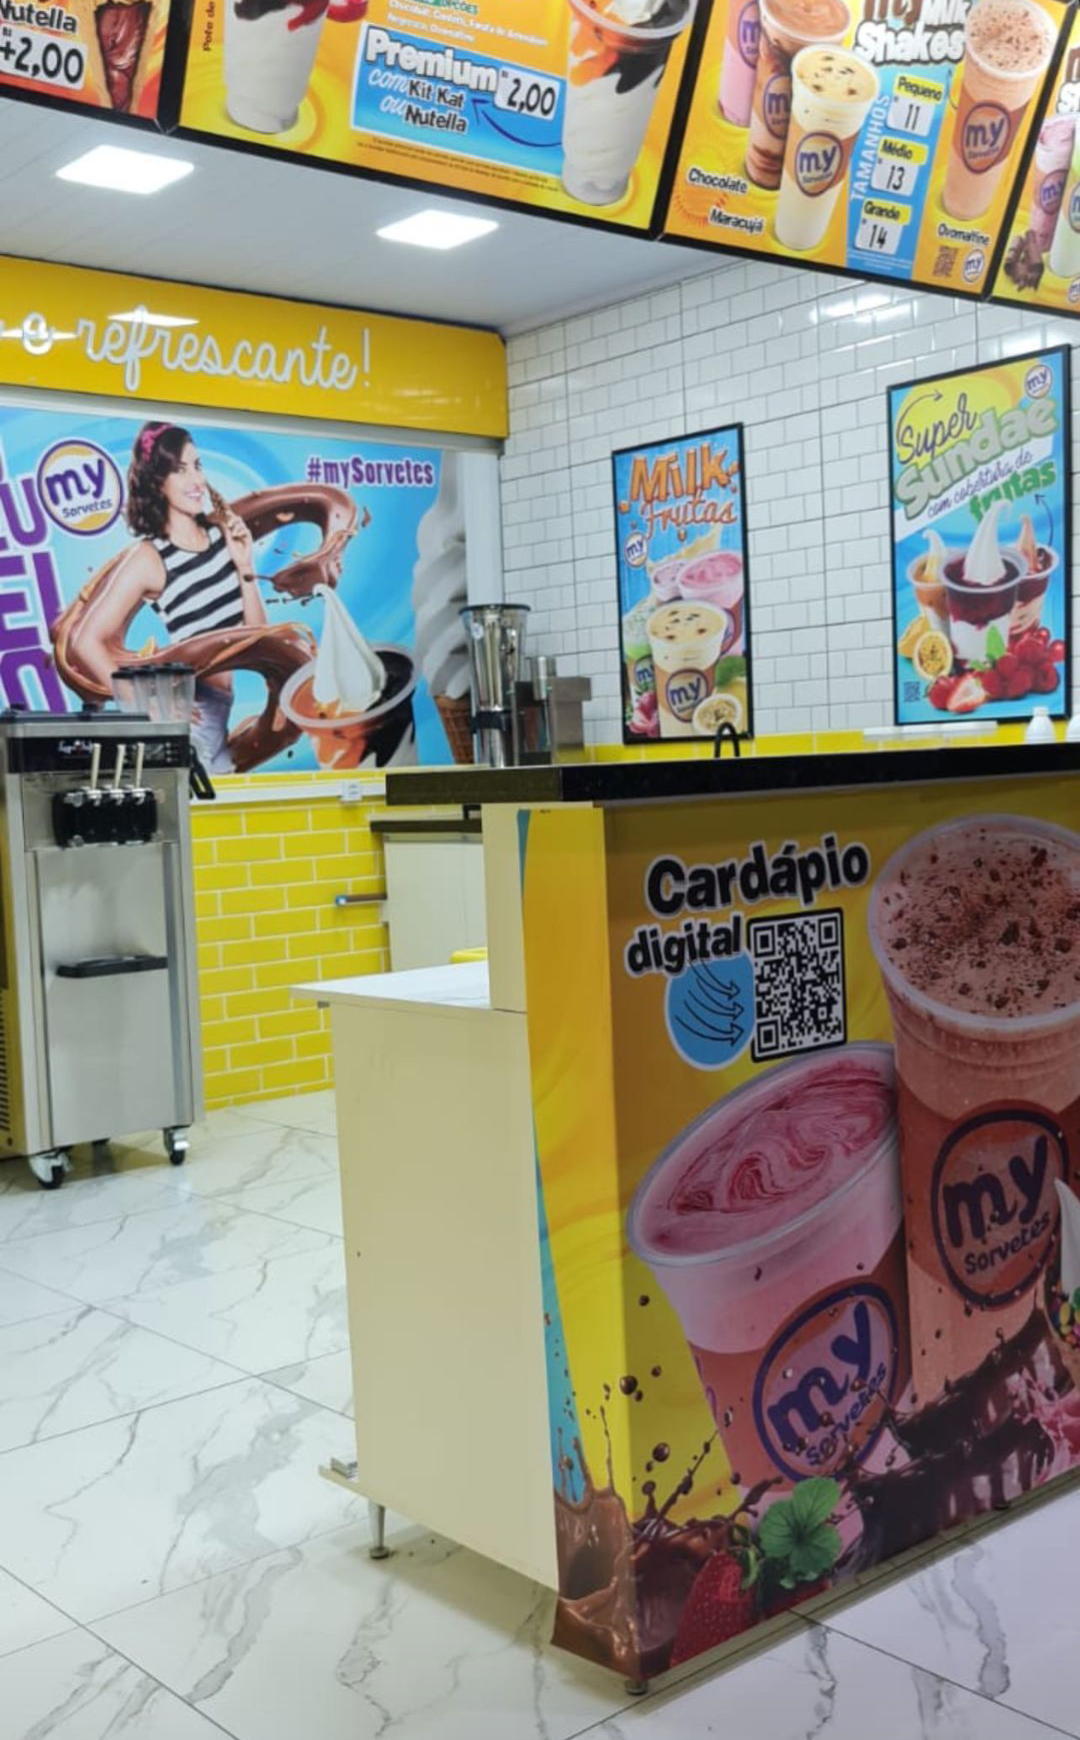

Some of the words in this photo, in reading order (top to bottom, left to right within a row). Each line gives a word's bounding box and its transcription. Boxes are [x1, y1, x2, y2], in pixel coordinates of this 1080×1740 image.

[0, 36, 84, 84] +2,00
[365, 27, 497, 92] Premium
[854, 20, 966, 65] Shakes
[369, 69, 407, 91] com
[408, 79, 433, 97] Kit
[437, 86, 464, 107] Kat
[507, 78, 556, 116] 2,00
[898, 76, 942, 101] Pequeno
[405, 104, 467, 132] Nutella
[905, 103, 920, 131] 11
[966, 118, 1004, 147] my
[800, 146, 837, 173] my
[852, 95, 889, 201] TAMANHOS
[881, 139, 913, 160] Médio
[689, 167, 748, 193] Chocolate
[887, 165, 905, 191] 13
[710, 208, 764, 233] Maracujá
[864, 201, 900, 220] Grande
[869, 224, 887, 249] 14
[938, 223, 990, 245] Ovomaltine
[77, 303, 371, 392] refrescante!
[1027, 368, 1048, 391] my
[897, 393, 977, 464] Super
[307, 457, 433, 489] #mySorvetes
[630, 443, 731, 502] Milk
[895, 398, 1057, 520] Sundae
[45, 458, 105, 506] my
[969, 461, 1056, 522] frutas
[62, 499, 112, 518] Sorvetes
[641, 484, 737, 539] Frutas
[626, 540, 644, 558] my
[670, 676, 702, 706] my
[648, 835, 869, 914] Cardápio
[628, 915, 741, 973] digital
[942, 1135, 1048, 1248] my
[964, 1211, 1050, 1274] Sorvetes
[768, 1301, 871, 1453] my
